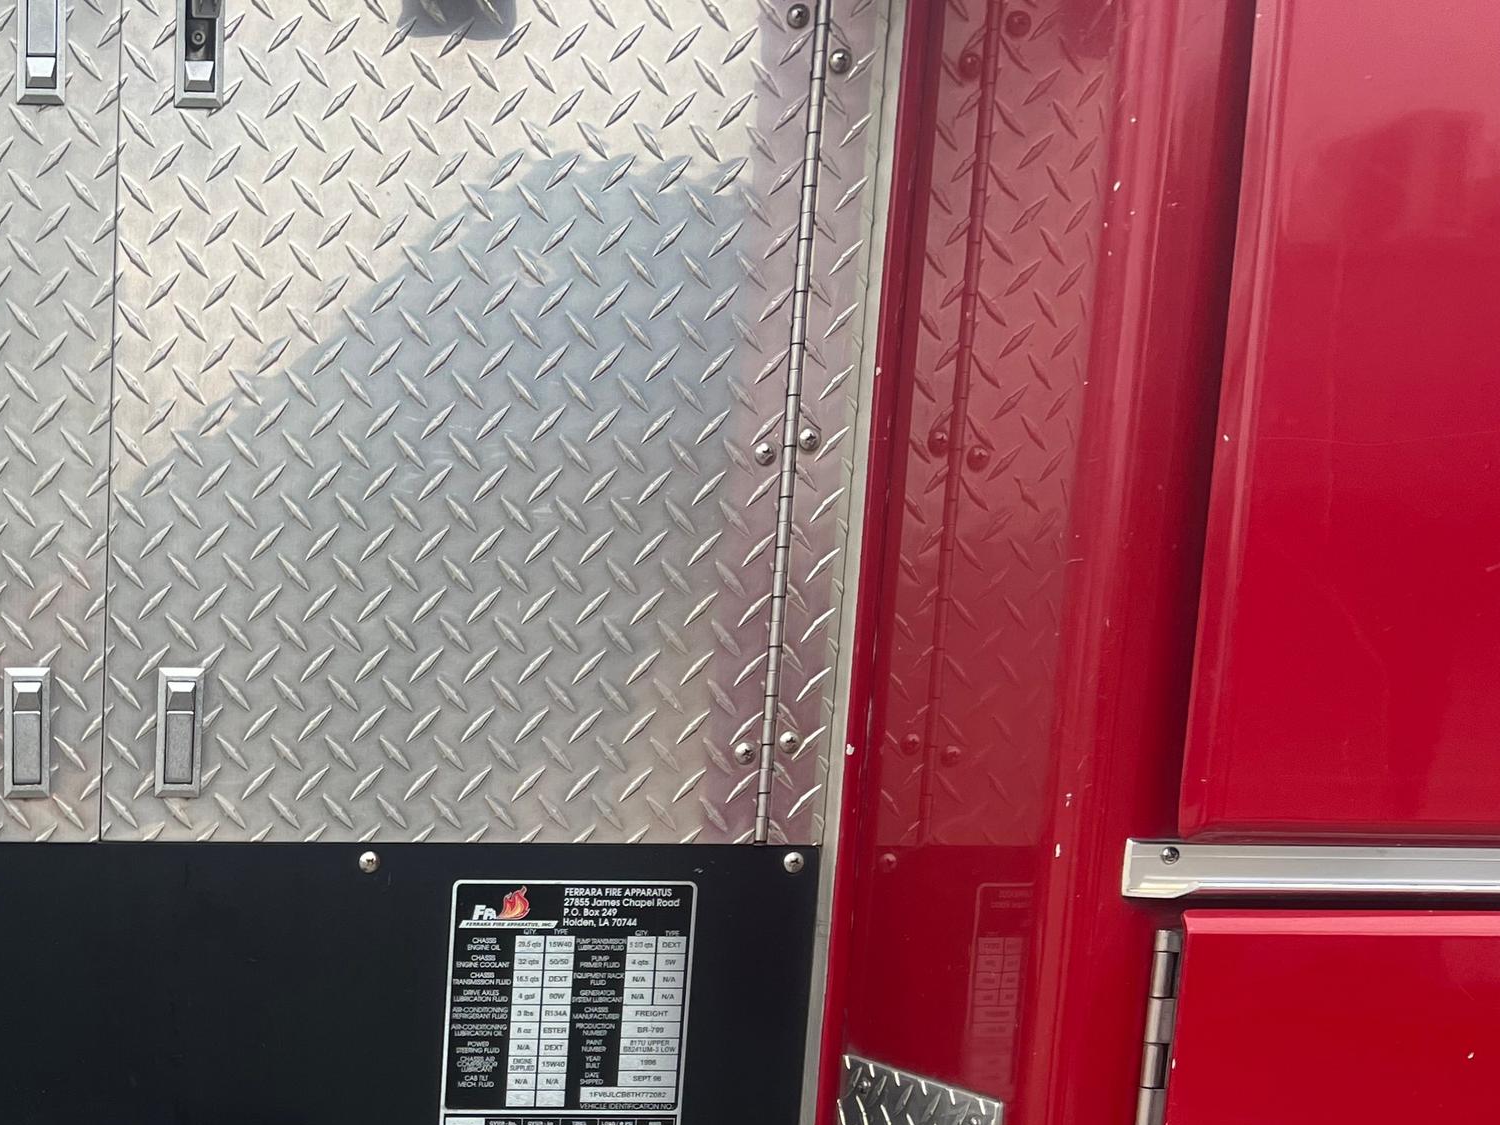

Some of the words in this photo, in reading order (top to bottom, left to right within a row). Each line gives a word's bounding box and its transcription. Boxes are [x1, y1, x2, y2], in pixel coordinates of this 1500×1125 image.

[564, 887, 603, 897] FERRARA
[605, 887, 622, 897] FIRE
[623, 887, 673, 897] APPARATUS
[563, 898, 590, 907] 27855
[591, 898, 620, 907] James
[622, 898, 655, 909] Chapel
[656, 898, 680, 907] Road
[563, 908, 581, 917] P.O.
[583, 908, 600, 917] Box
[601, 908, 618, 917] 249
[562, 918, 597, 928] Holden,
[598, 918, 610, 927] LA
[611, 918, 637, 927] 70744
